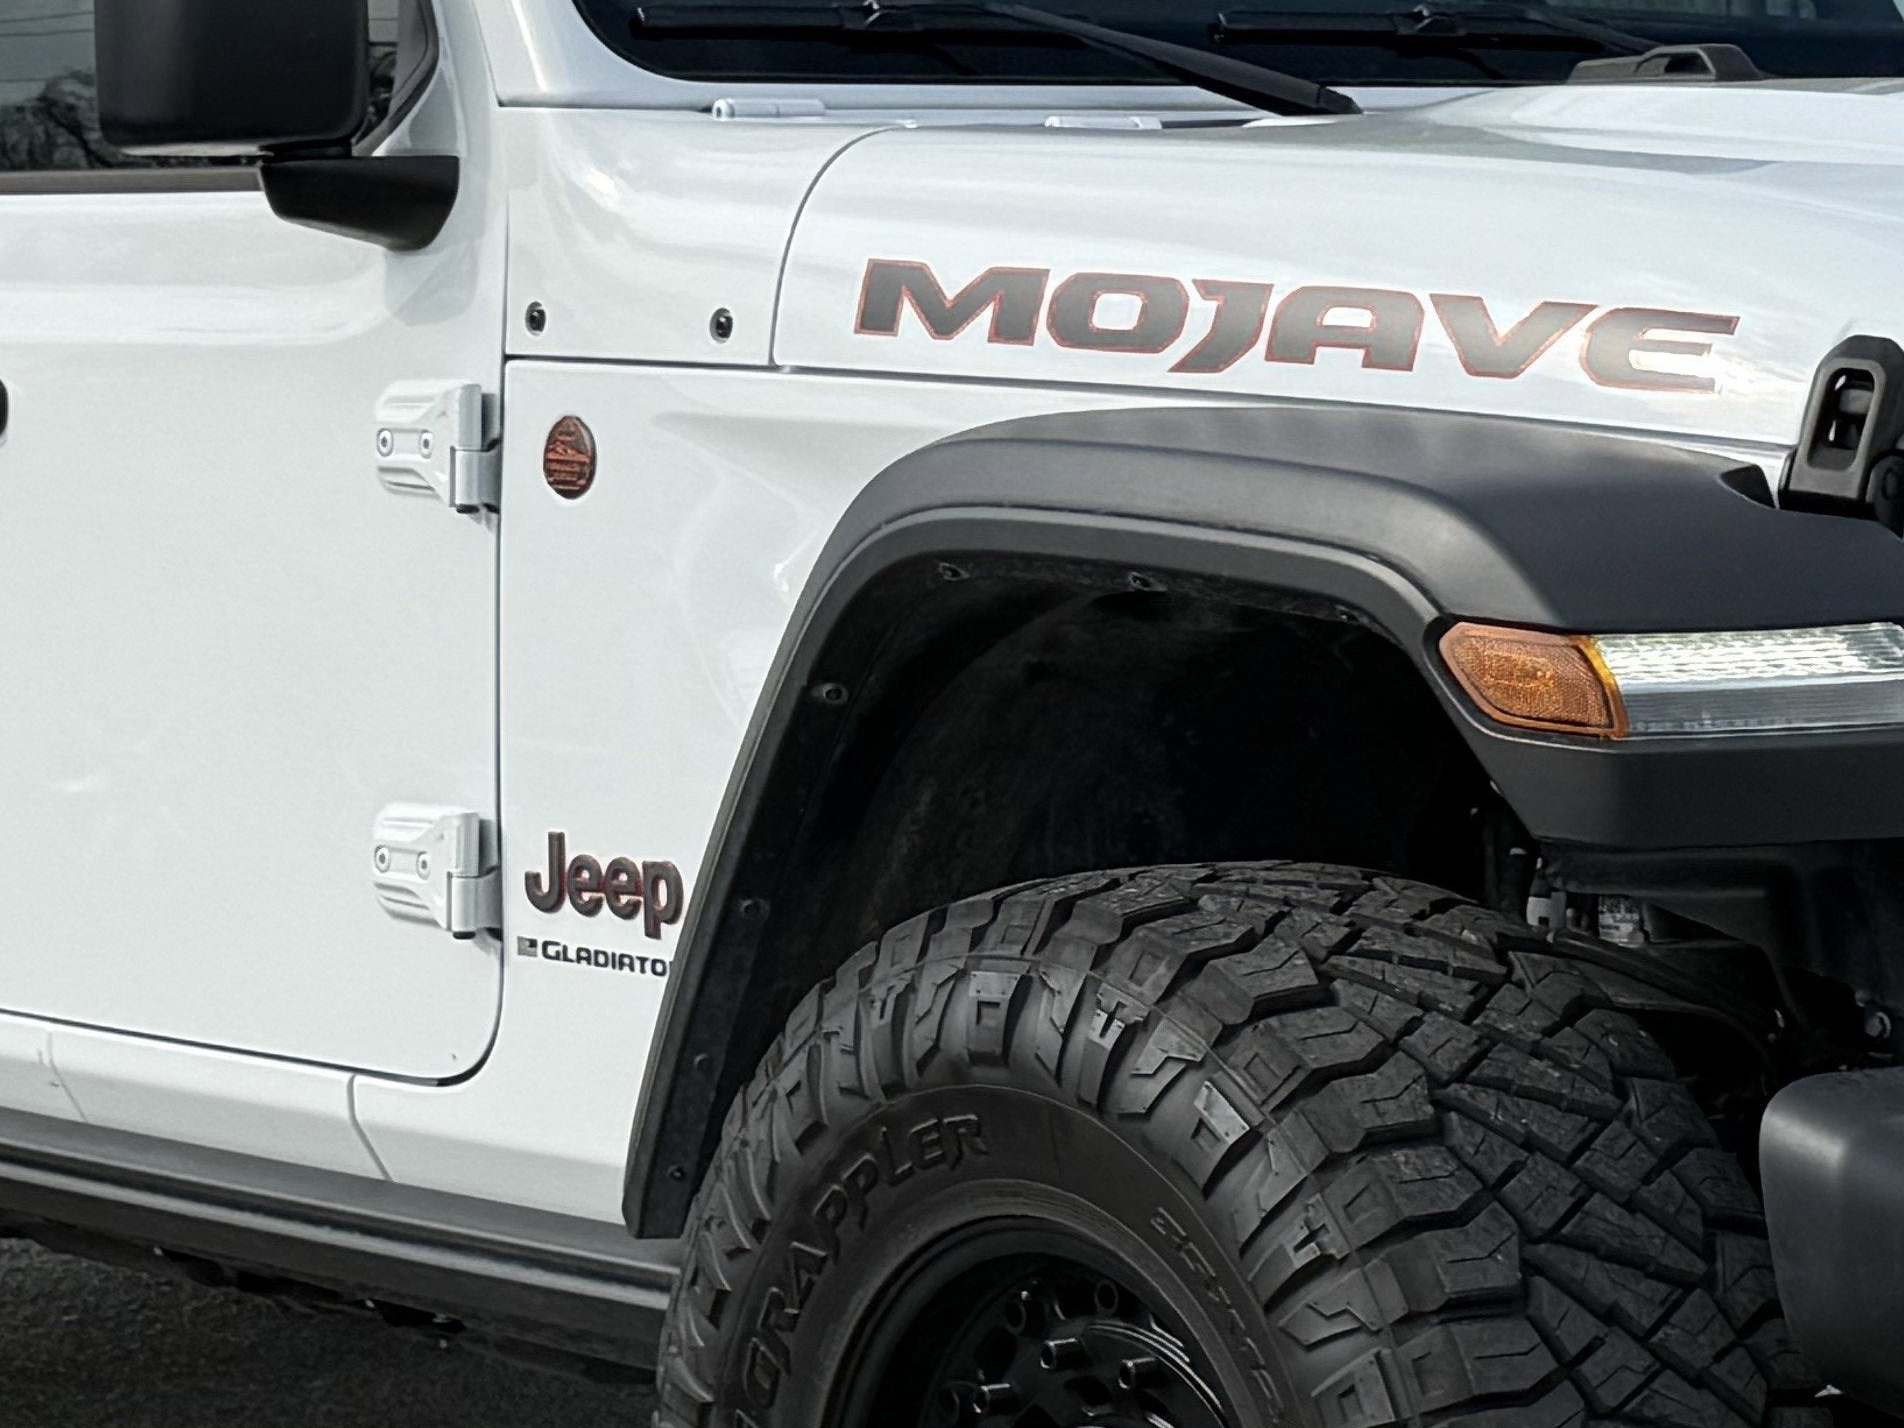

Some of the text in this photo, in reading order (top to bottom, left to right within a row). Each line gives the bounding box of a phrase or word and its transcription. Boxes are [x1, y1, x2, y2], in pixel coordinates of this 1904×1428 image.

[852, 258, 1739, 393] MOJAVE
[524, 830, 684, 940] Jeep
[541, 939, 673, 977] GLADIATO
